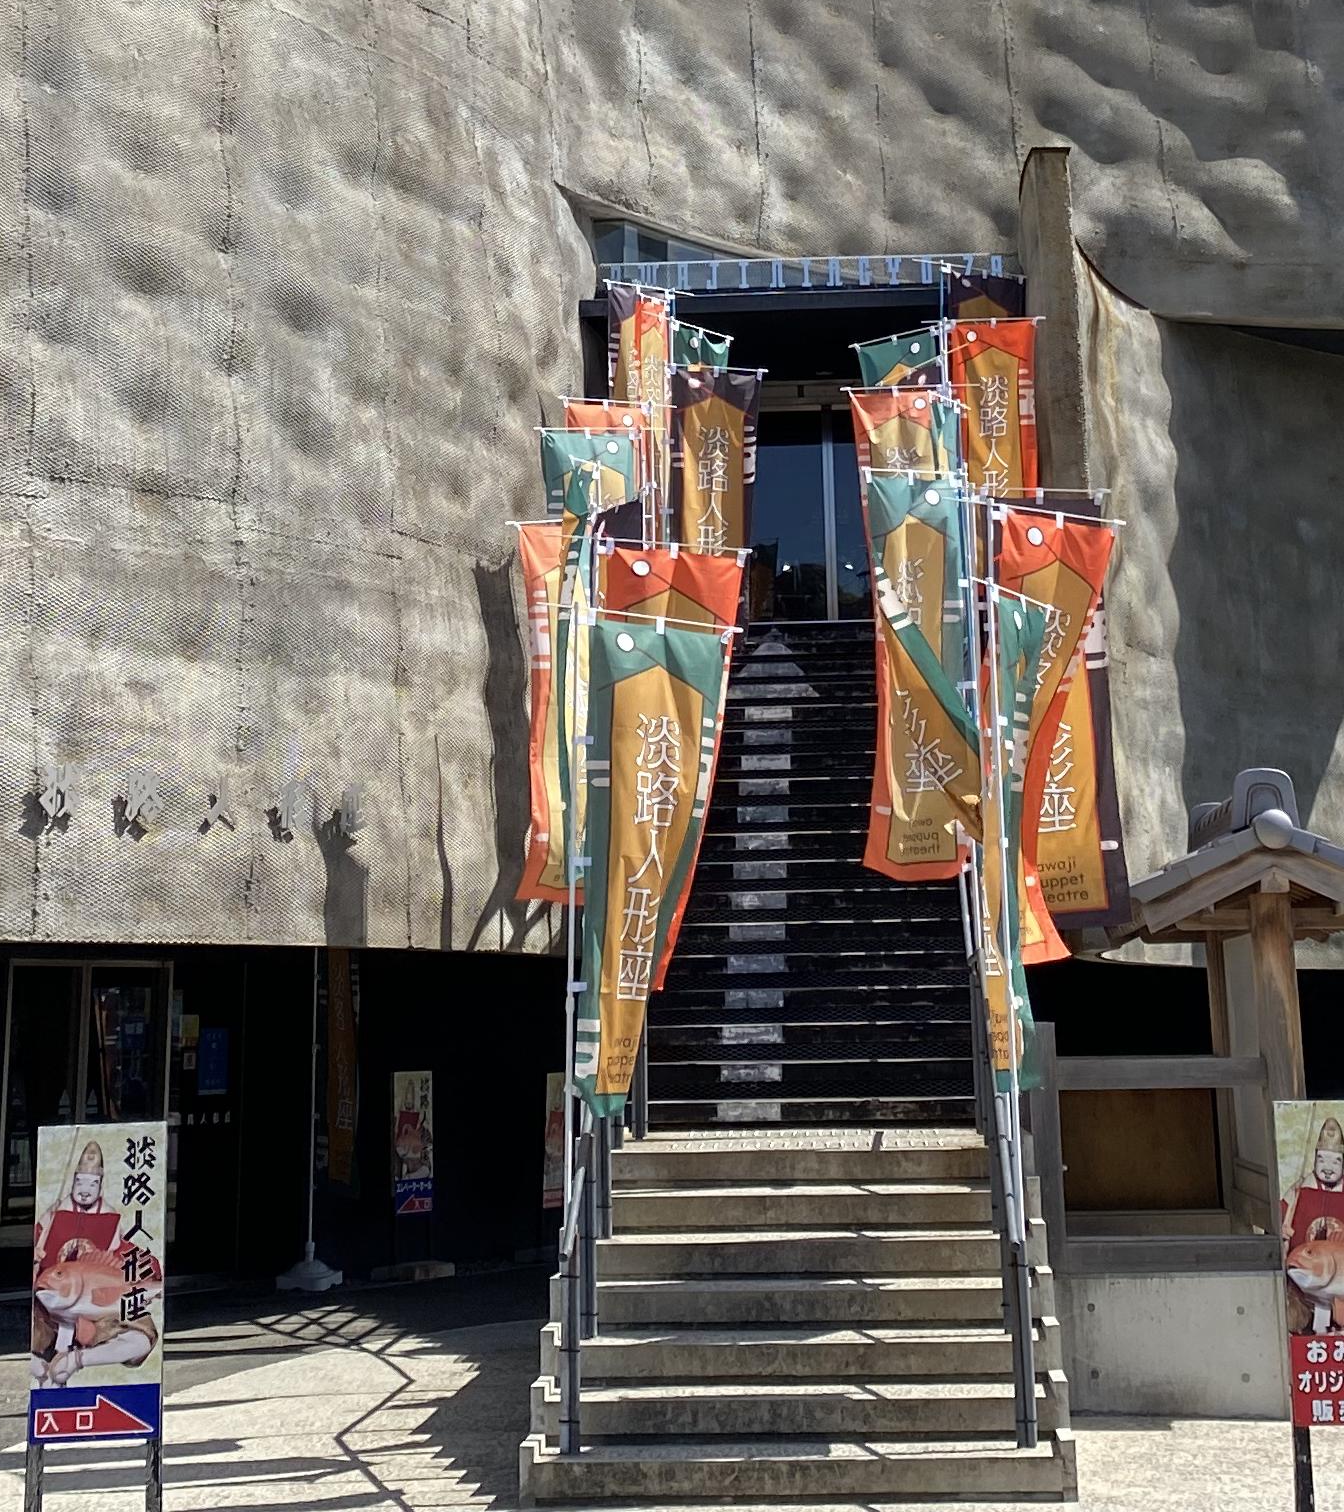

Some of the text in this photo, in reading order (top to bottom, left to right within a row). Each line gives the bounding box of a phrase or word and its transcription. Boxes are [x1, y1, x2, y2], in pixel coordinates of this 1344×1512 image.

[616, 712, 680, 1001] 淡路人形座
[1037, 856, 1076, 873] awaji
[1040, 873, 1084, 890] uppet
[1045, 890, 1089, 903] eatre
[121, 1136, 156, 1322] 淡路人形座
[40, 1411, 93, 1432] 入口
